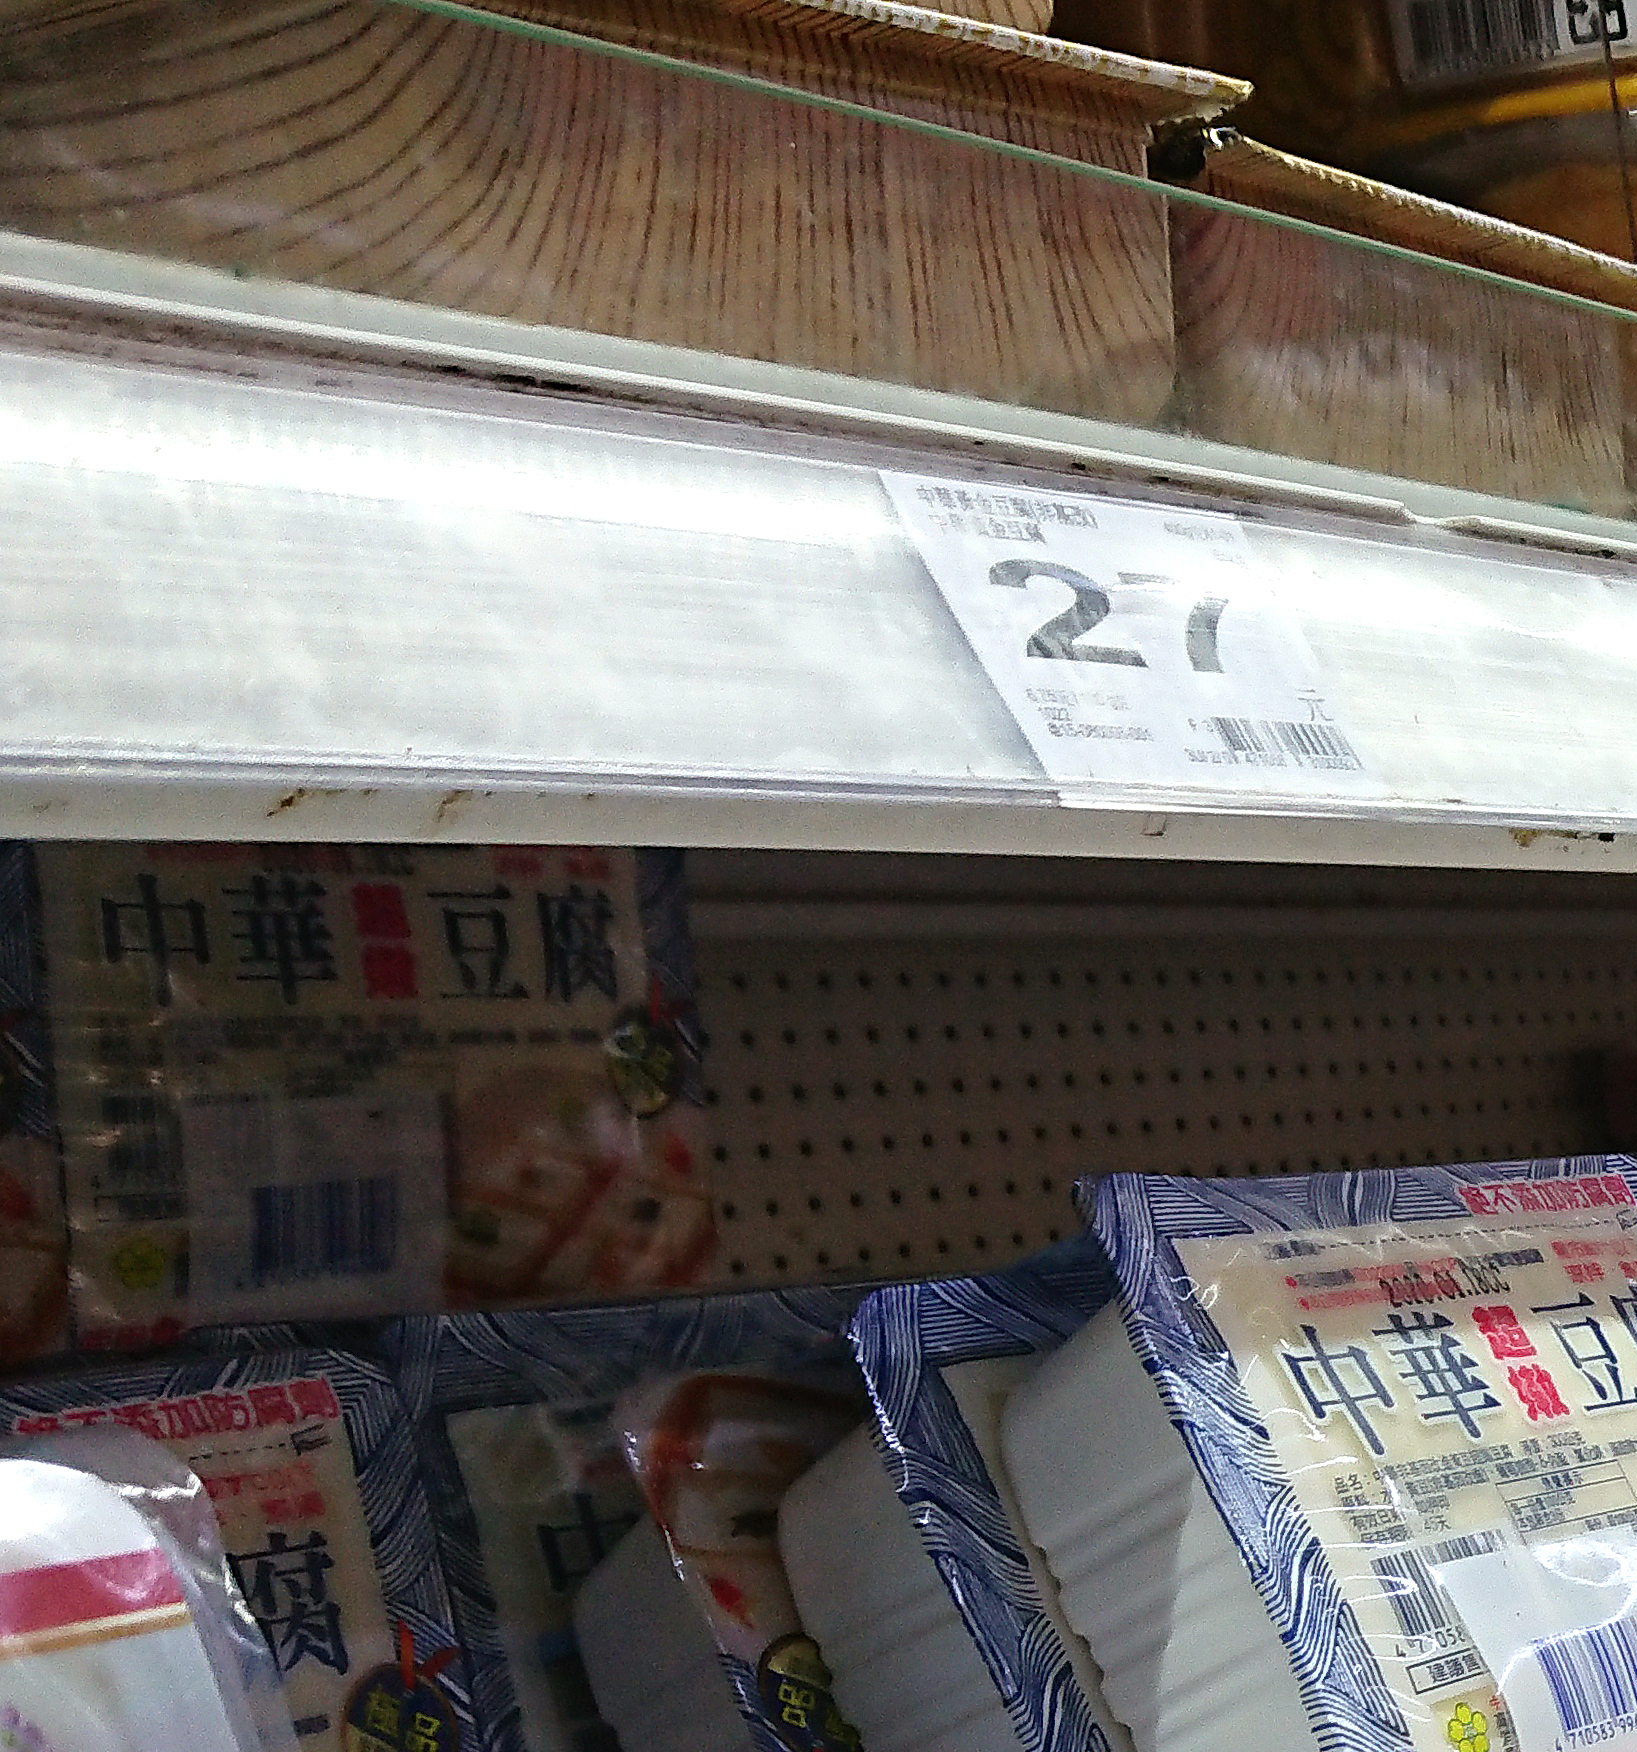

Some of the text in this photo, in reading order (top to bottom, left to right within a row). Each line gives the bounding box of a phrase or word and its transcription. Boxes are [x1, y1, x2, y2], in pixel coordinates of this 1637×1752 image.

[988, 558, 1228, 674] 27
[100, 874, 338, 1005] 中華
[1280, 1311, 1503, 1456] 中華
[1472, 1305, 1571, 1422] 超嫩
[226, 1531, 349, 1675] 腐
